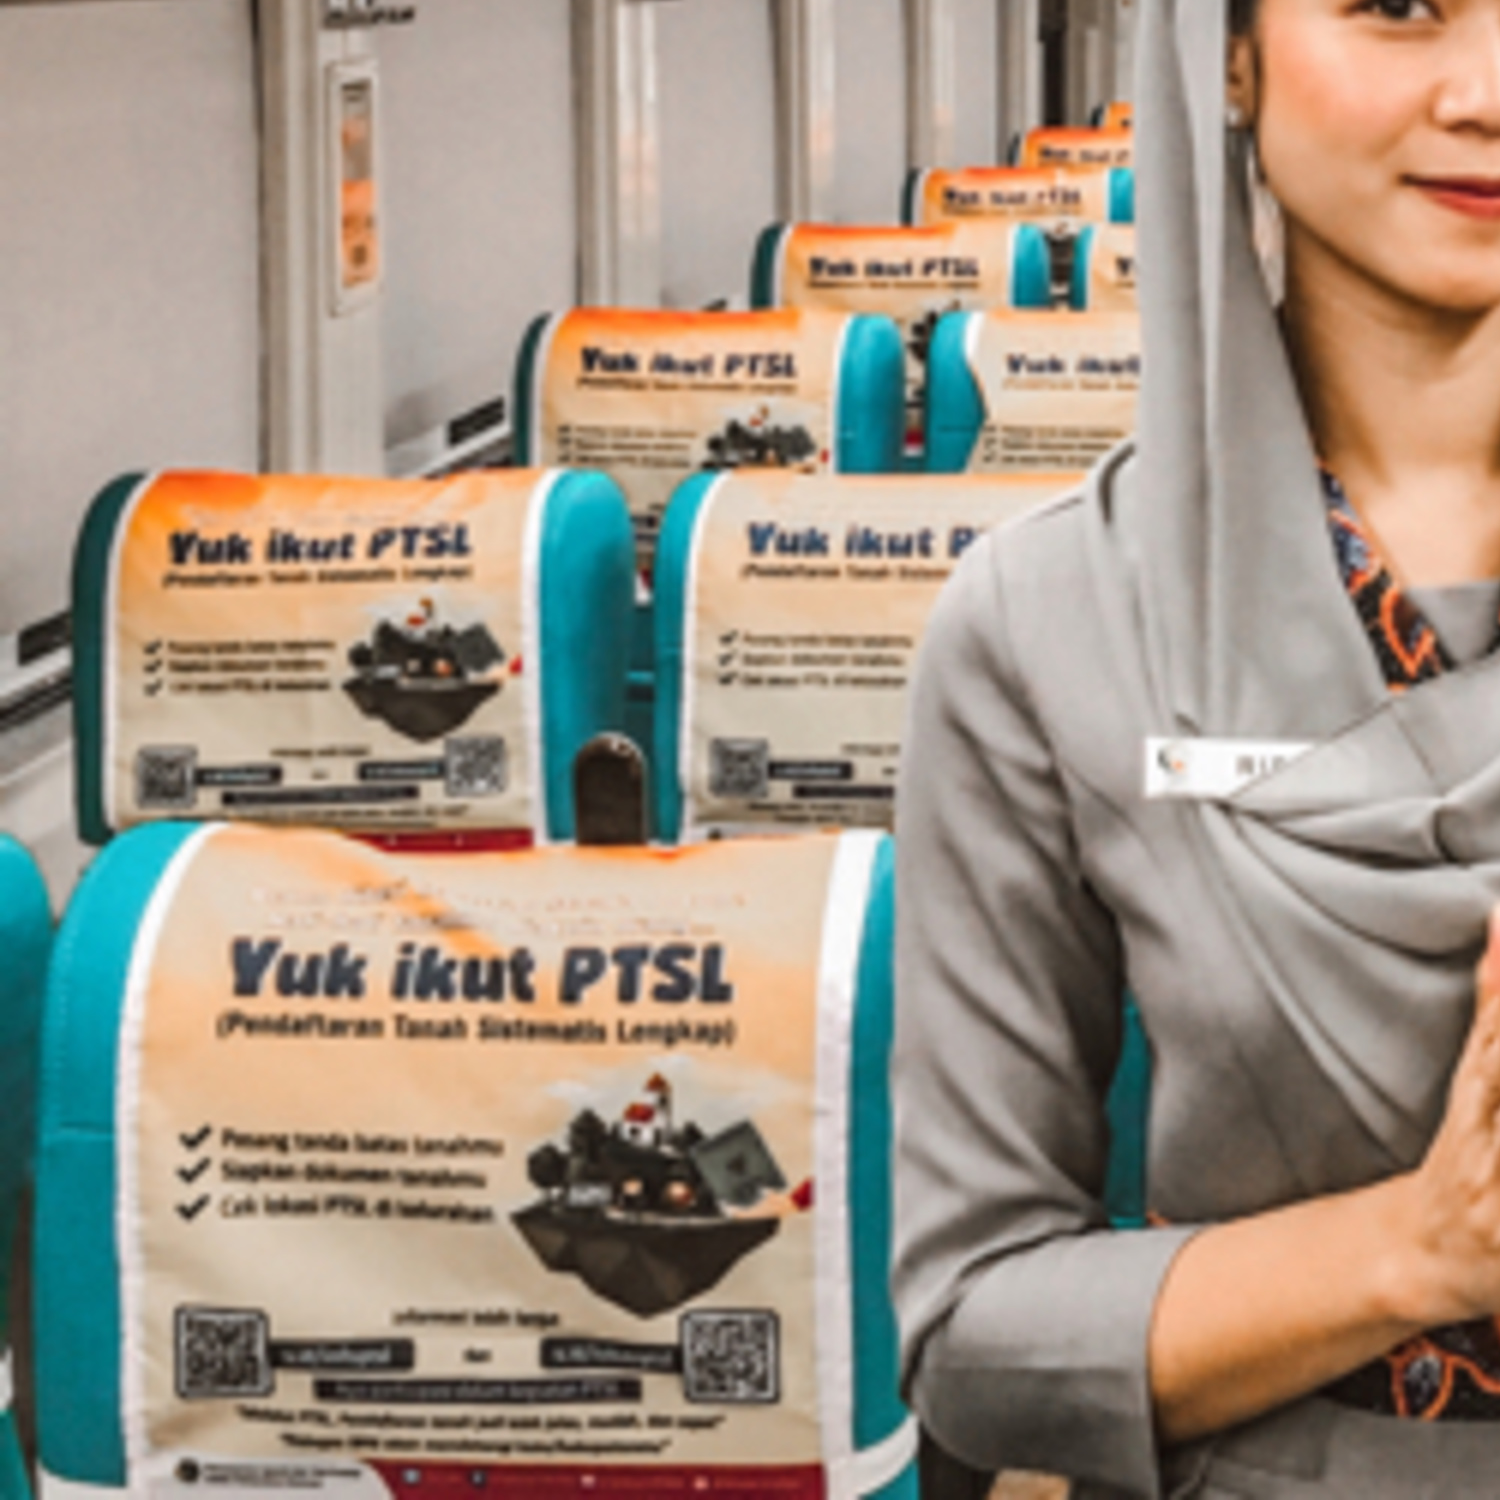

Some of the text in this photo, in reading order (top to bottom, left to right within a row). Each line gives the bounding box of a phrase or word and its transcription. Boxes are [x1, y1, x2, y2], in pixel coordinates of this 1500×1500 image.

[581, 346, 796, 378] Yuk ikut PTSL
[169, 523, 472, 565] Yuk ikut PTSL
[747, 522, 829, 556] Yuk
[845, 523, 934, 558] ikut
[231, 937, 733, 1005] Yuk ikut PTSL
[217, 1011, 737, 1048] (Pendaftaran Tanah Sistematis Lengkap)
